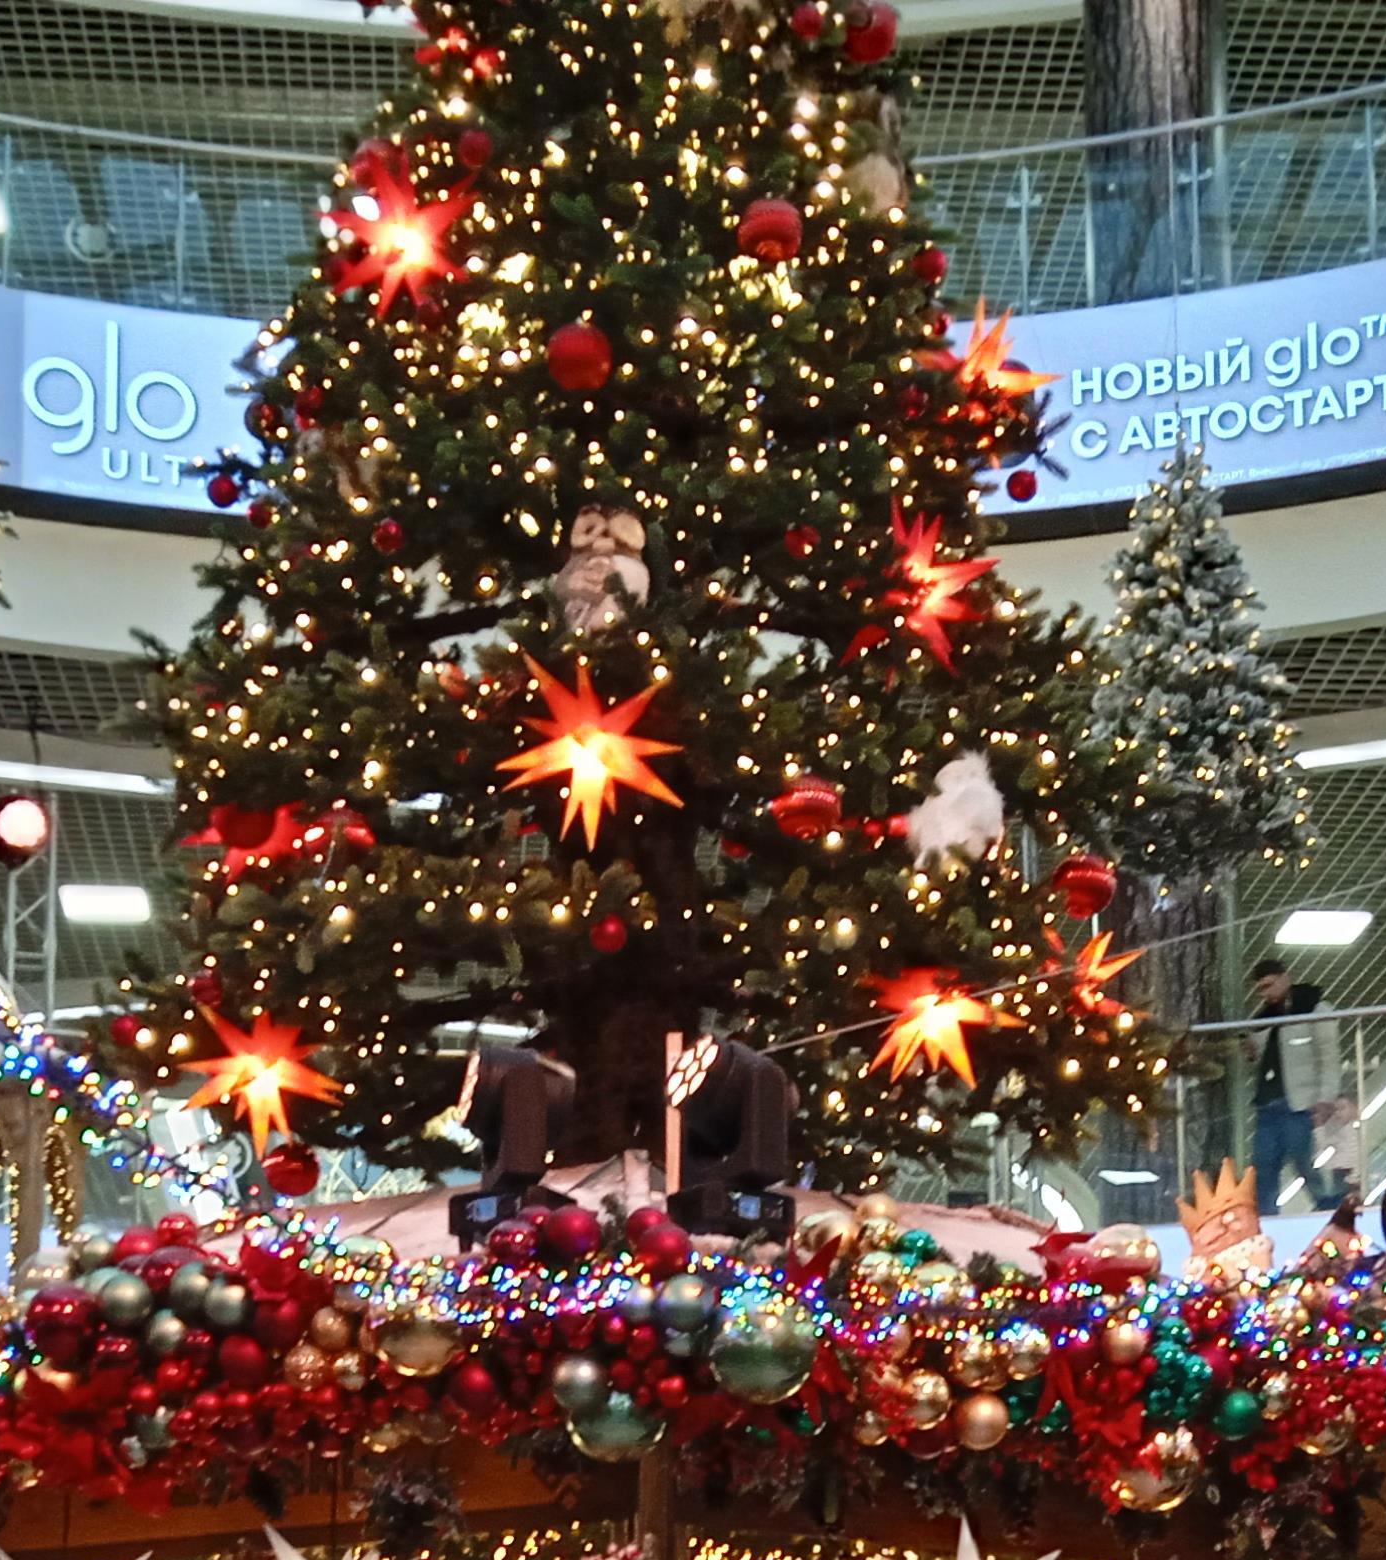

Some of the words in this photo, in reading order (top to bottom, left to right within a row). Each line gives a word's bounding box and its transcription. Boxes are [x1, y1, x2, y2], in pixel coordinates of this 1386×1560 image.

[23, 320, 199, 456] glo
[1071, 336, 1251, 407] НОВЫЙ
[1070, 419, 1108, 460] С
